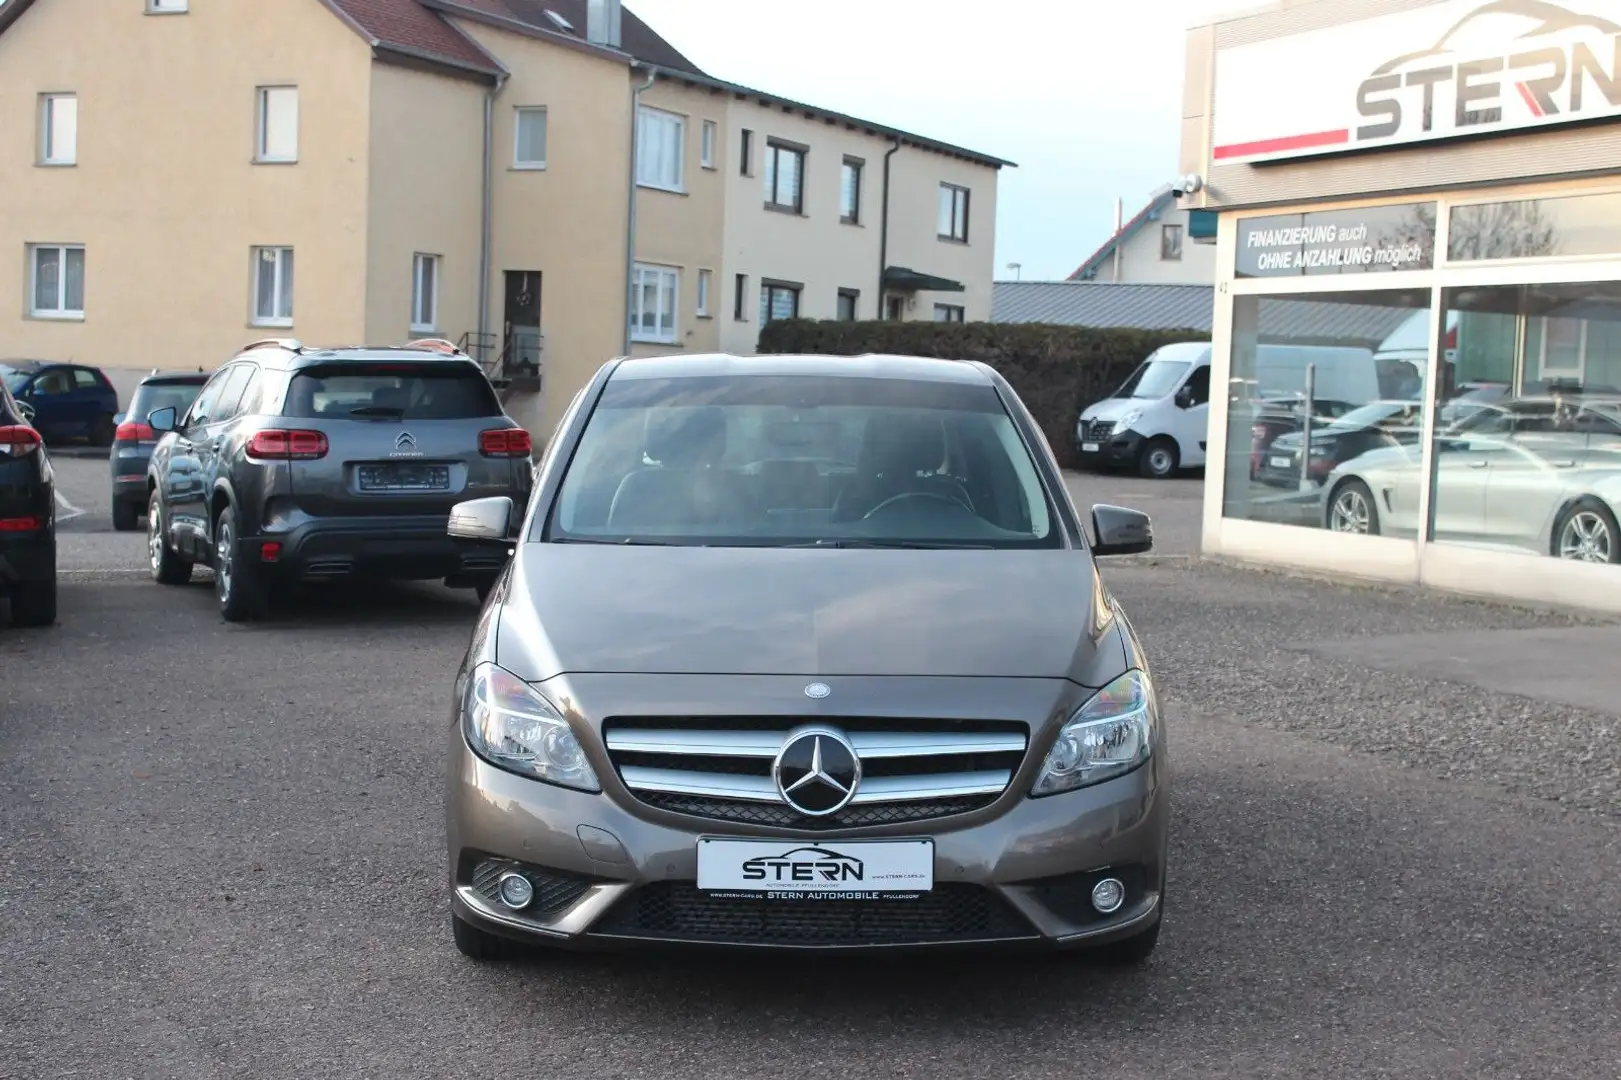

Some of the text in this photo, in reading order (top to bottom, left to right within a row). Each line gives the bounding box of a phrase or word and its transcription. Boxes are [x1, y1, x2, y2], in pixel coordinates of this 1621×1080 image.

[1356, 34, 1621, 141] STERN
[1247, 223, 1367, 248] FINANZIERUNG auch
[1258, 244, 1421, 270] OHNE ANZAHLUNG möglich
[742, 861, 864, 881] STERN
[767, 891, 804, 899] STERN
[807, 891, 879, 899] AUTOMOBILE
